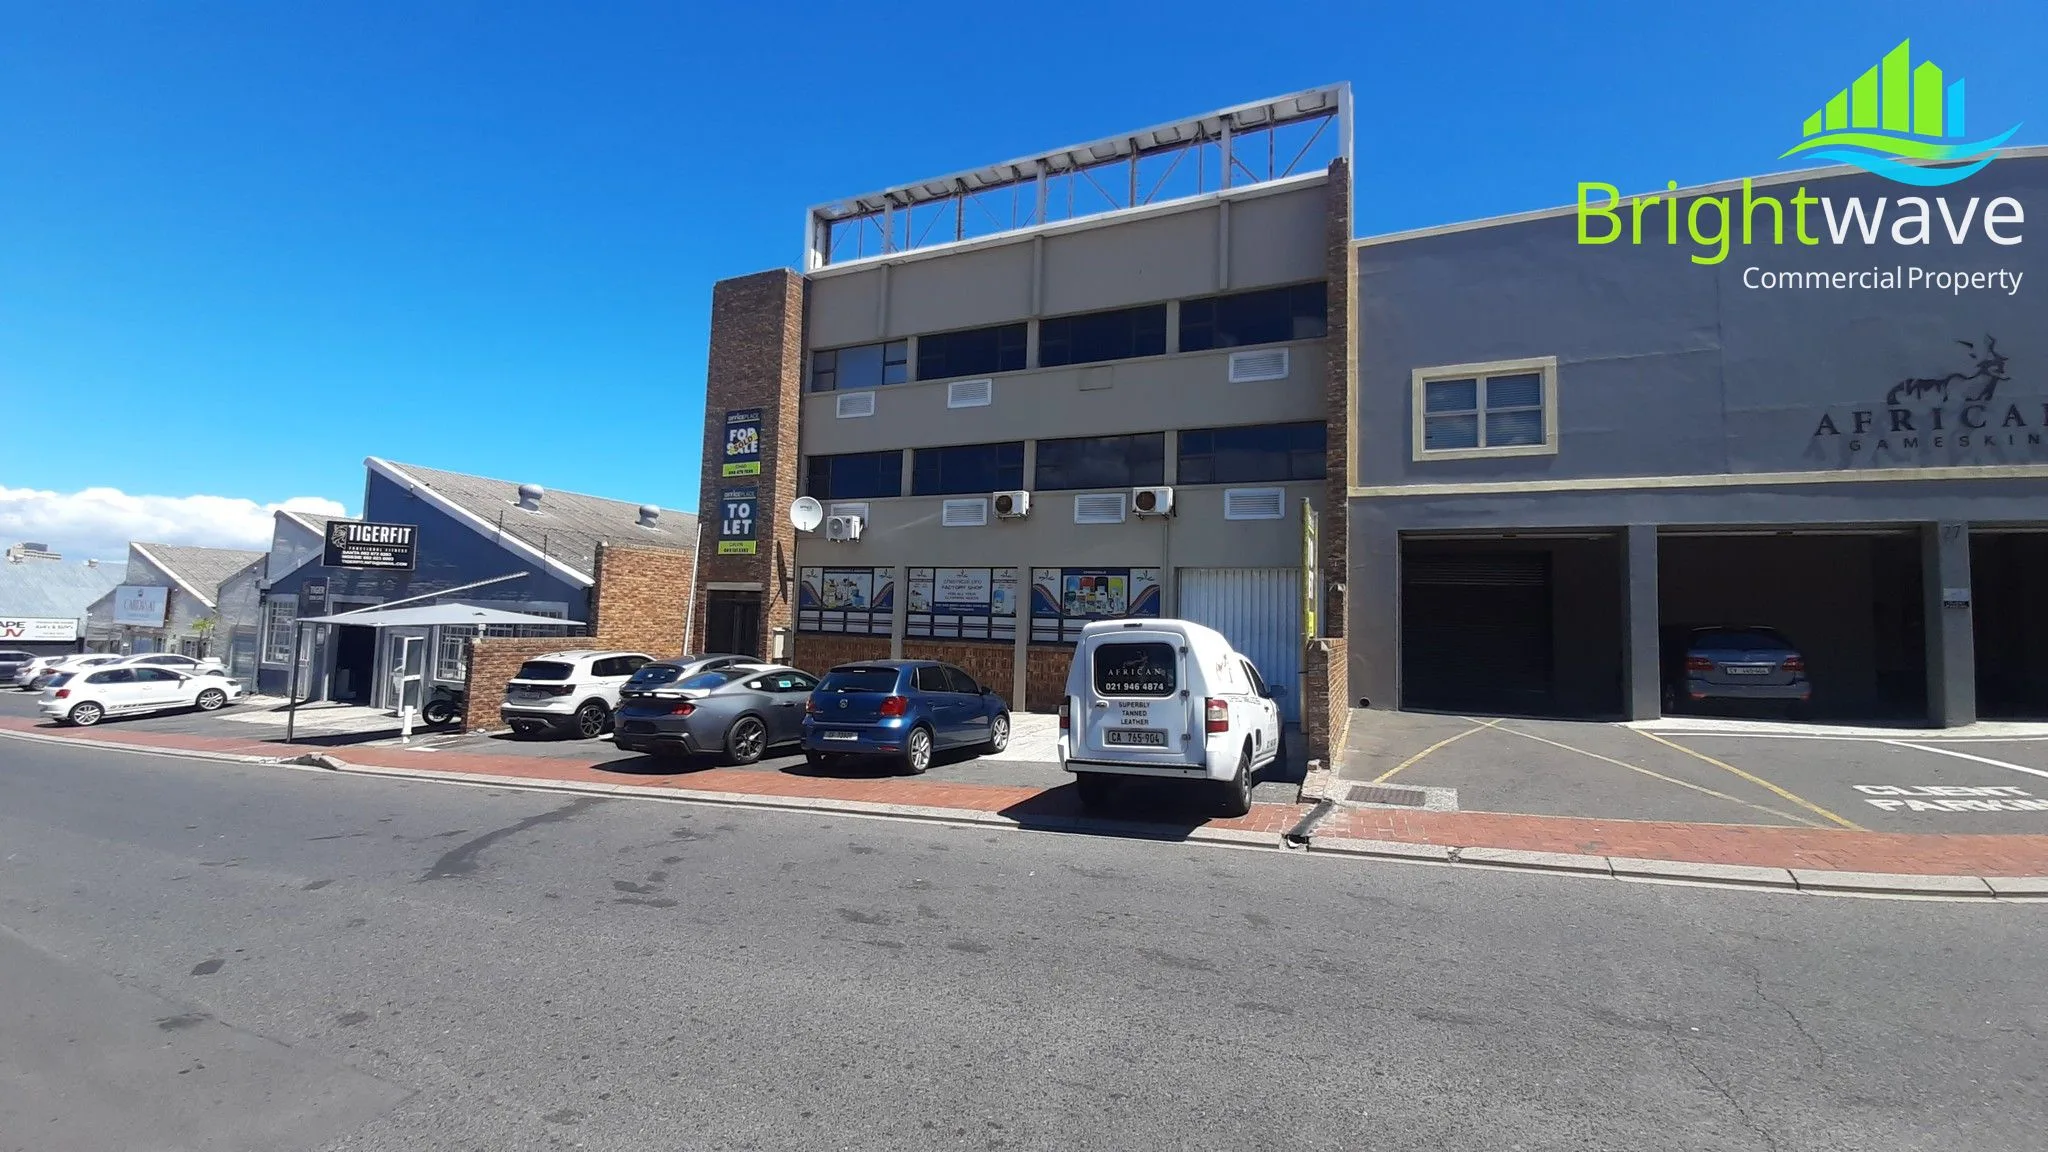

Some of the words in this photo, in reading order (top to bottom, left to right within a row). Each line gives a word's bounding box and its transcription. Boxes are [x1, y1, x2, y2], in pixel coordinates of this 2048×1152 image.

[727, 502, 750, 518] TO
[723, 519, 752, 535] LET
[348, 524, 411, 544] TIGERFIT
[1108, 668, 1162, 677] AFRICAN
[1105, 682, 1121, 691] 021
[1123, 682, 1140, 691] 946
[1142, 682, 1164, 691] 4874
[1111, 733, 1122, 742] CA
[1127, 732, 1160, 743] 765-904
[1852, 785, 2032, 797] CLIENT
